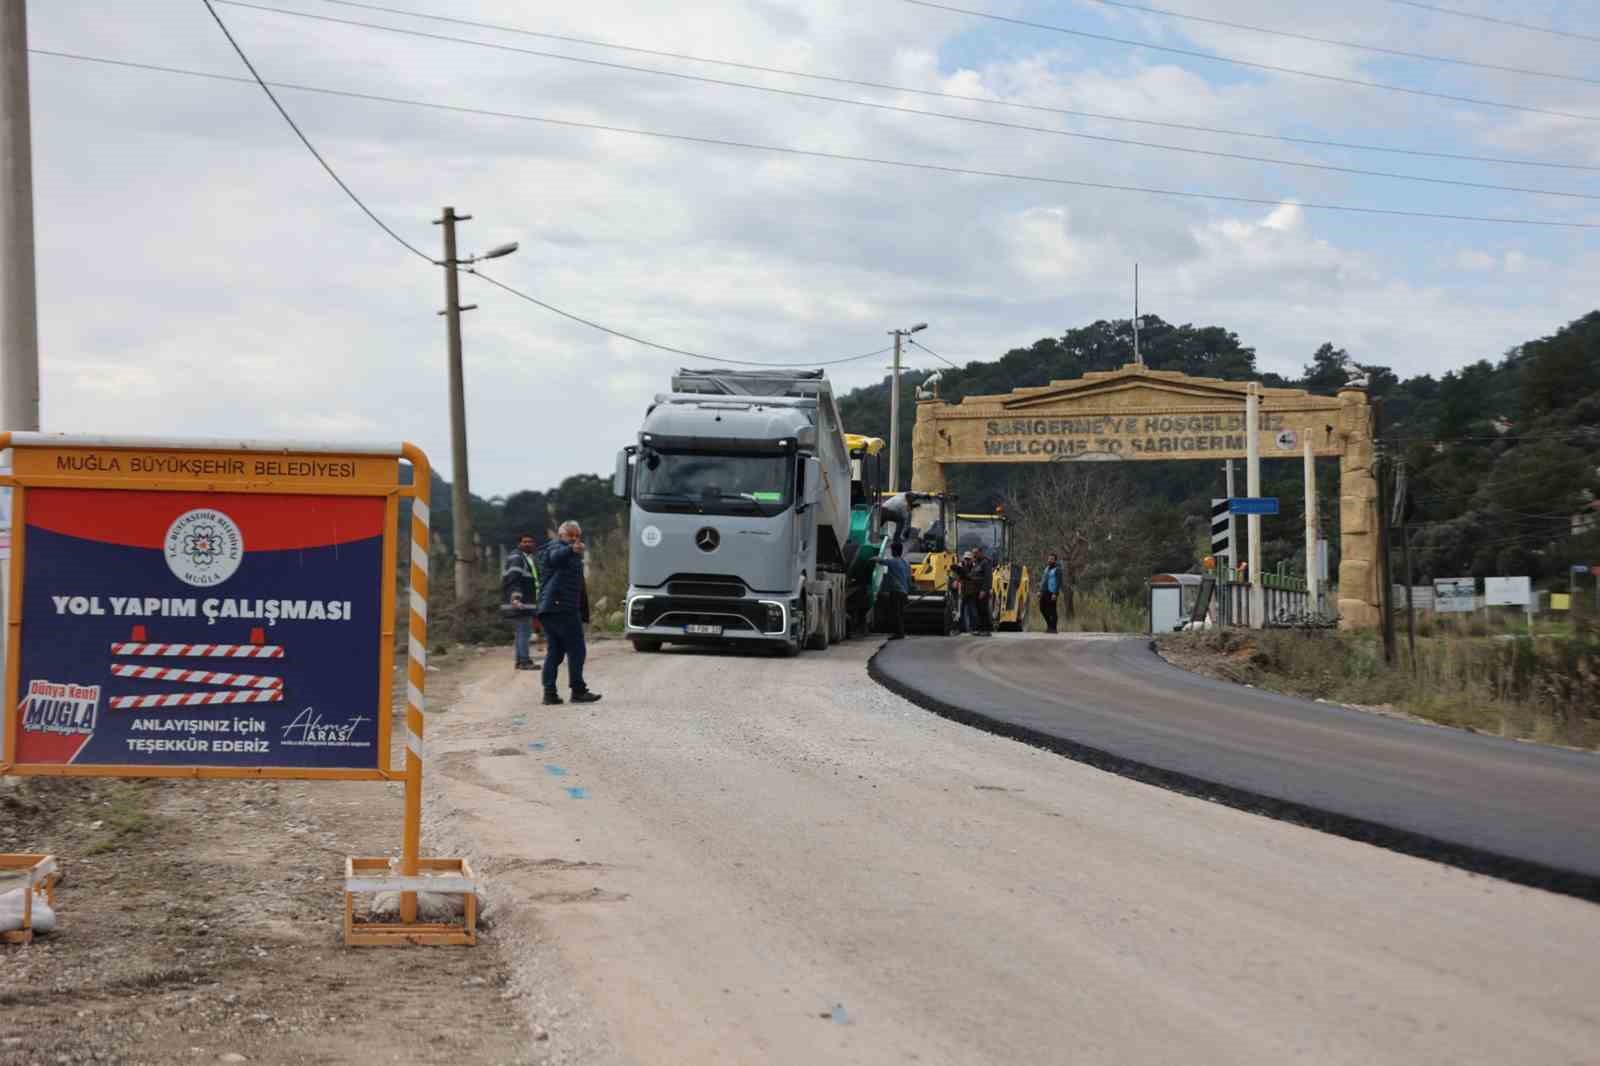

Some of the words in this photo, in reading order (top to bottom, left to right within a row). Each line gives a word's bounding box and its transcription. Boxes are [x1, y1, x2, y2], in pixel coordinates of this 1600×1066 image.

[984, 439, 1087, 455] WELCOME
[1094, 438, 1122, 453] TO
[56, 455, 120, 472] MUĞLA
[131, 457, 244, 476] BÜYÜKŞEHİR
[255, 460, 356, 477] BELEDİYESİ
[185, 572, 221, 583] MUĞLA
[52, 596, 105, 615] YOL
[109, 597, 196, 616] YAPIM
[202, 598, 351, 625] ÇALIŞMASI
[32, 683, 64, 698] Dünya
[69, 687, 97, 701] Kenti
[131, 719, 229, 735] ANLAYIŞINIZ
[233, 717, 266, 735] İÇİN
[281, 706, 371, 742] Ahmet
[307, 730, 346, 741] ARAS
[127, 738, 208, 754] TEŞEKKÜR
[211, 737, 270, 753] EDERİZ
